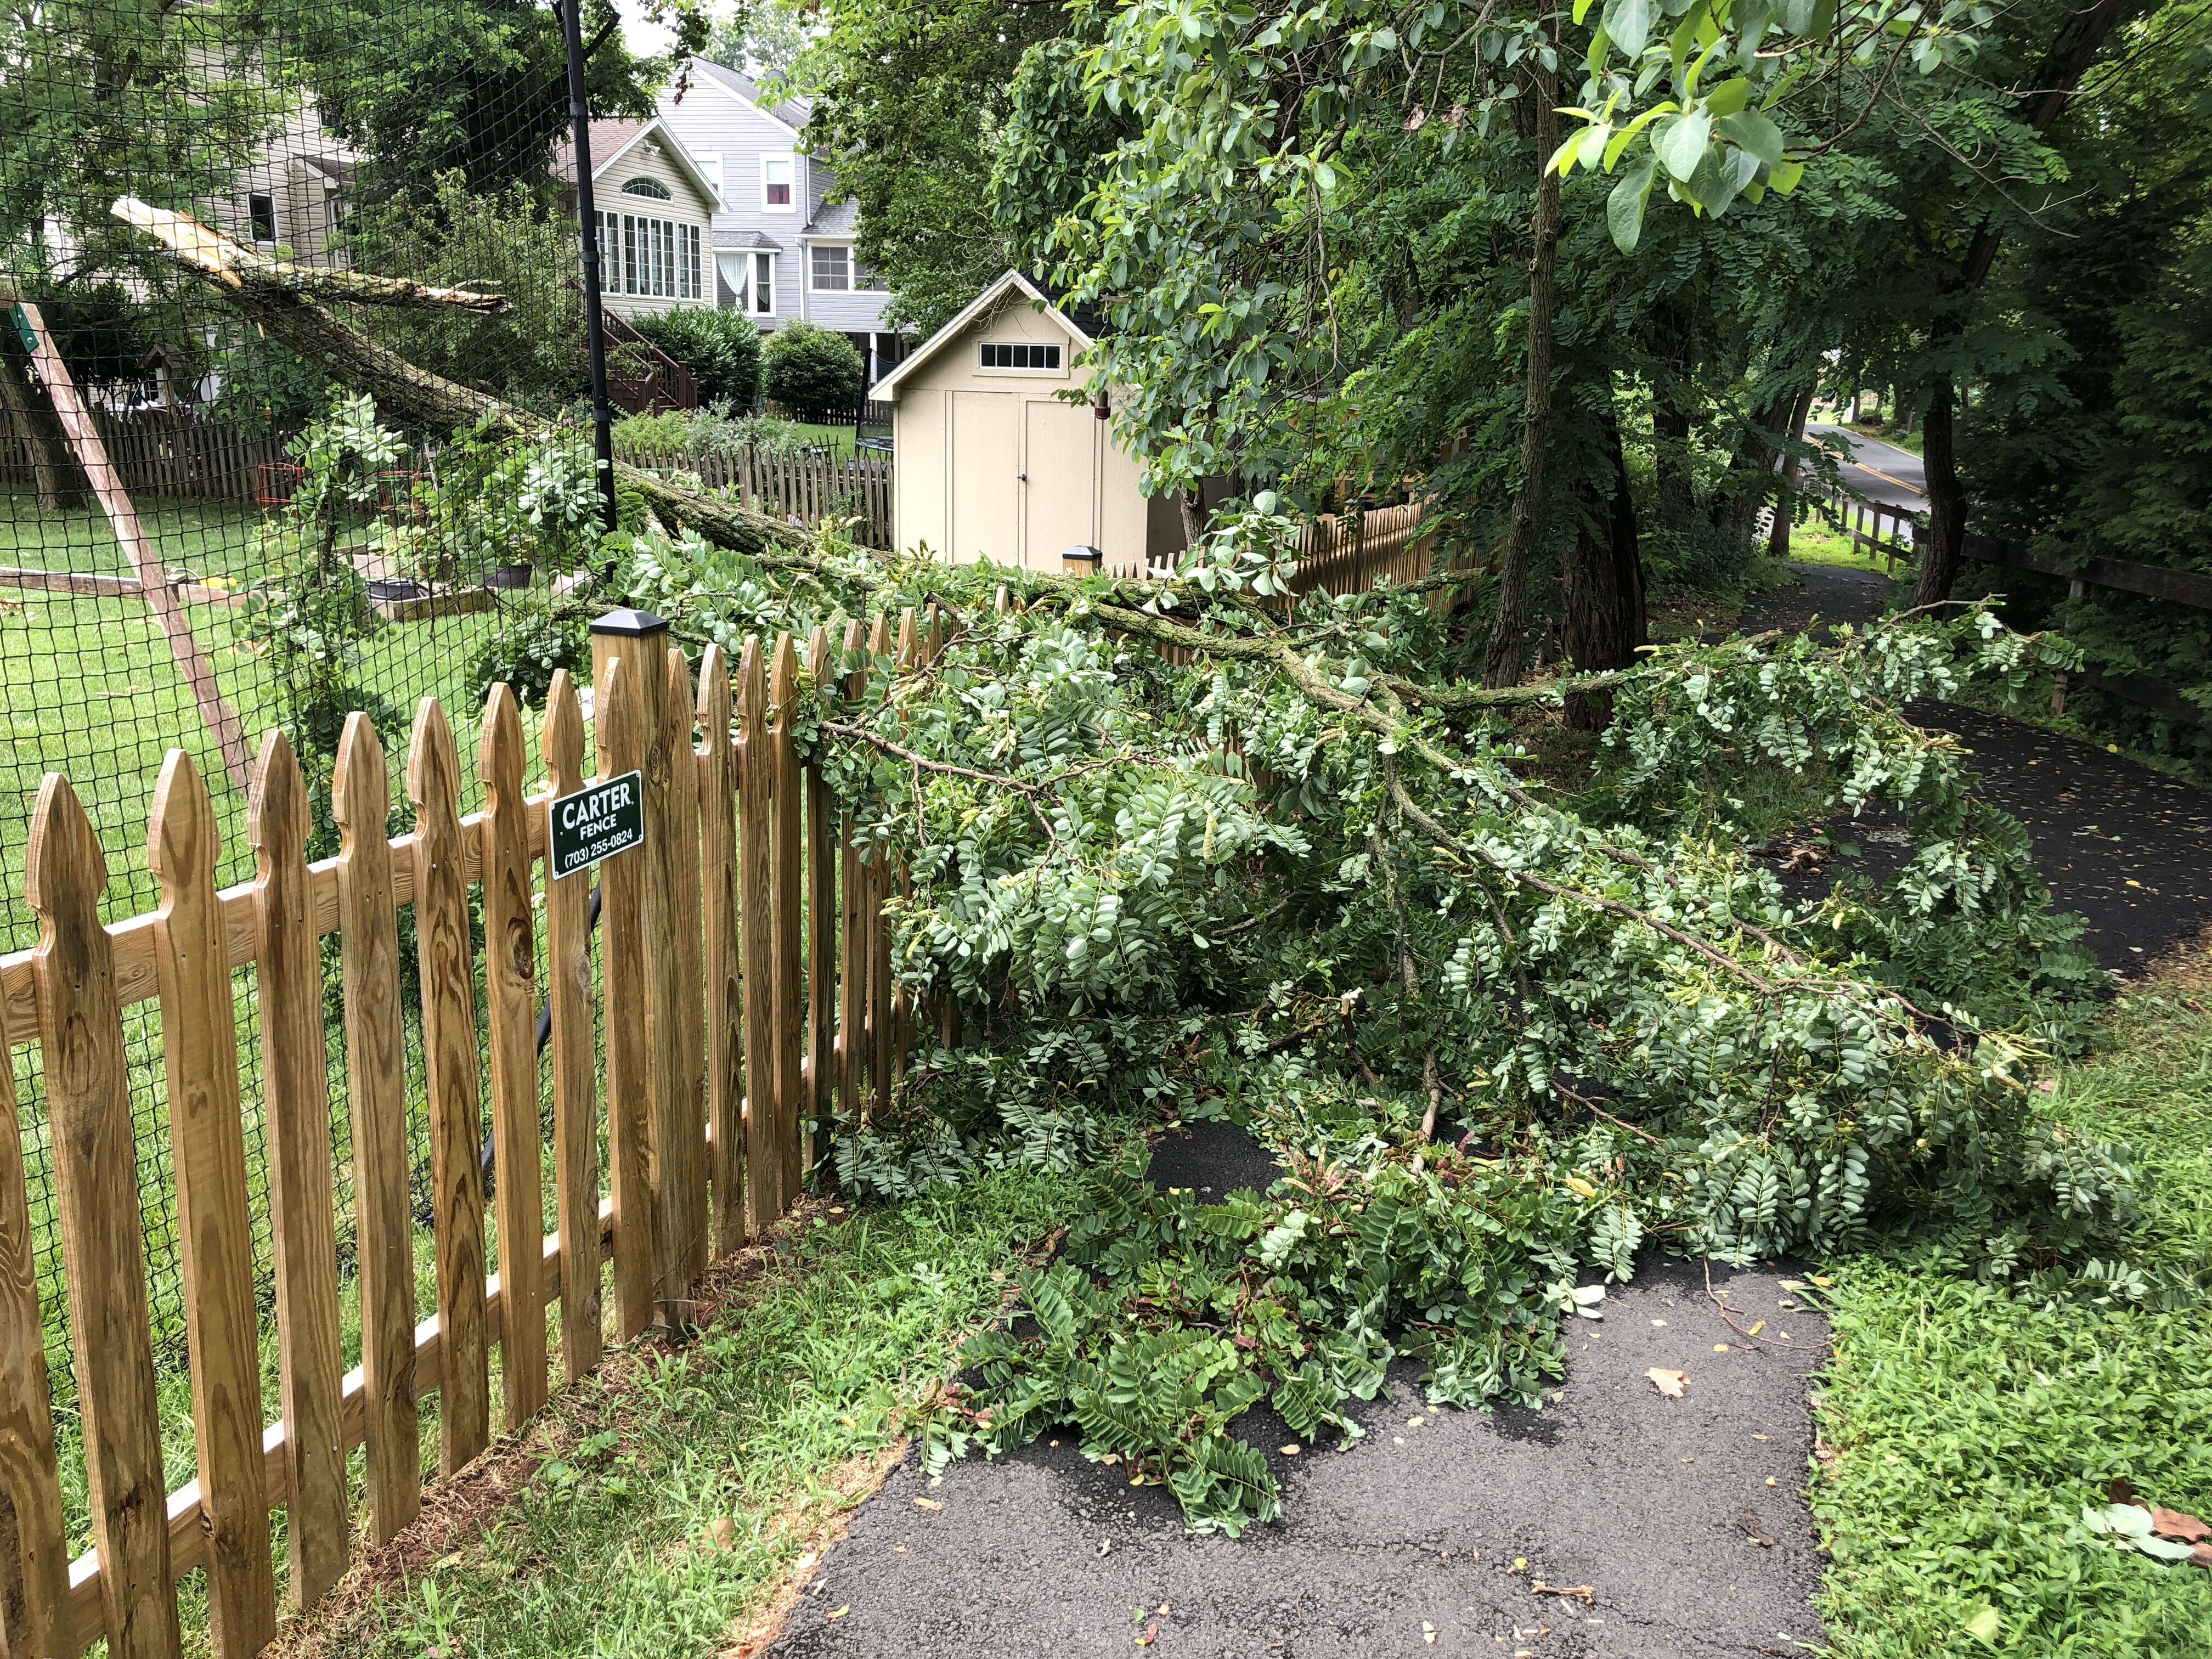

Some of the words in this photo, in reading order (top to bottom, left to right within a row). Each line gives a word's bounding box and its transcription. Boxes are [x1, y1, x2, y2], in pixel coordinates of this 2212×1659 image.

[563, 783, 631, 829] CARTER
[580, 814, 617, 840] FENCE
[565, 847, 589, 868] (703)
[591, 828, 633, 857] 255-0824
